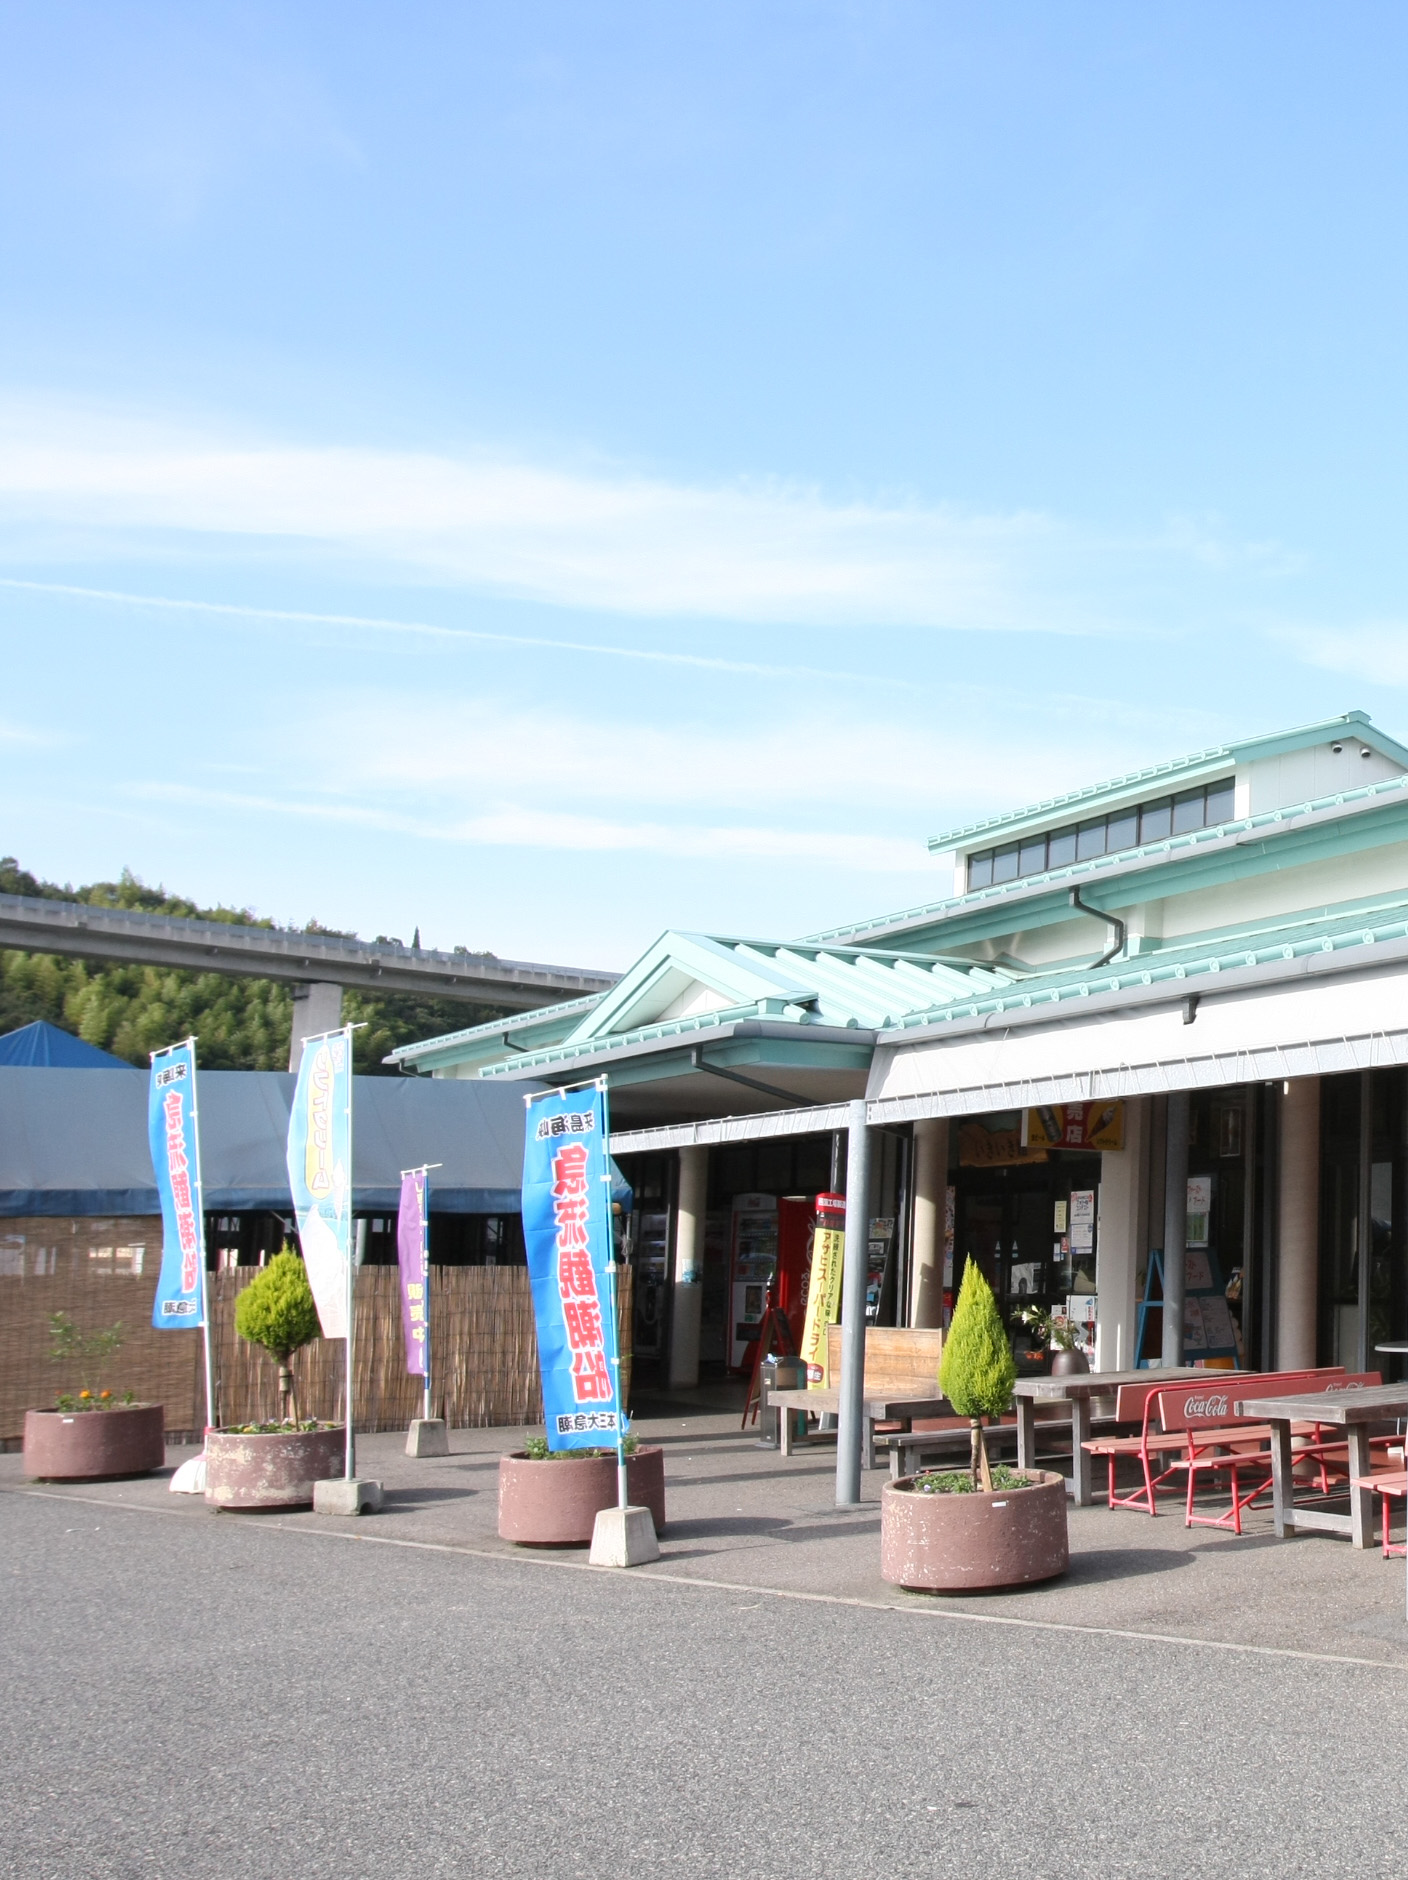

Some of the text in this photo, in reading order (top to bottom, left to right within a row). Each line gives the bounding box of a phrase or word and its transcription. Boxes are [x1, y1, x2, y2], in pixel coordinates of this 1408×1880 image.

[808, 1231, 832, 1361] アサヒスーパードライ
[1184, 1394, 1229, 1419] Coca-Cola
